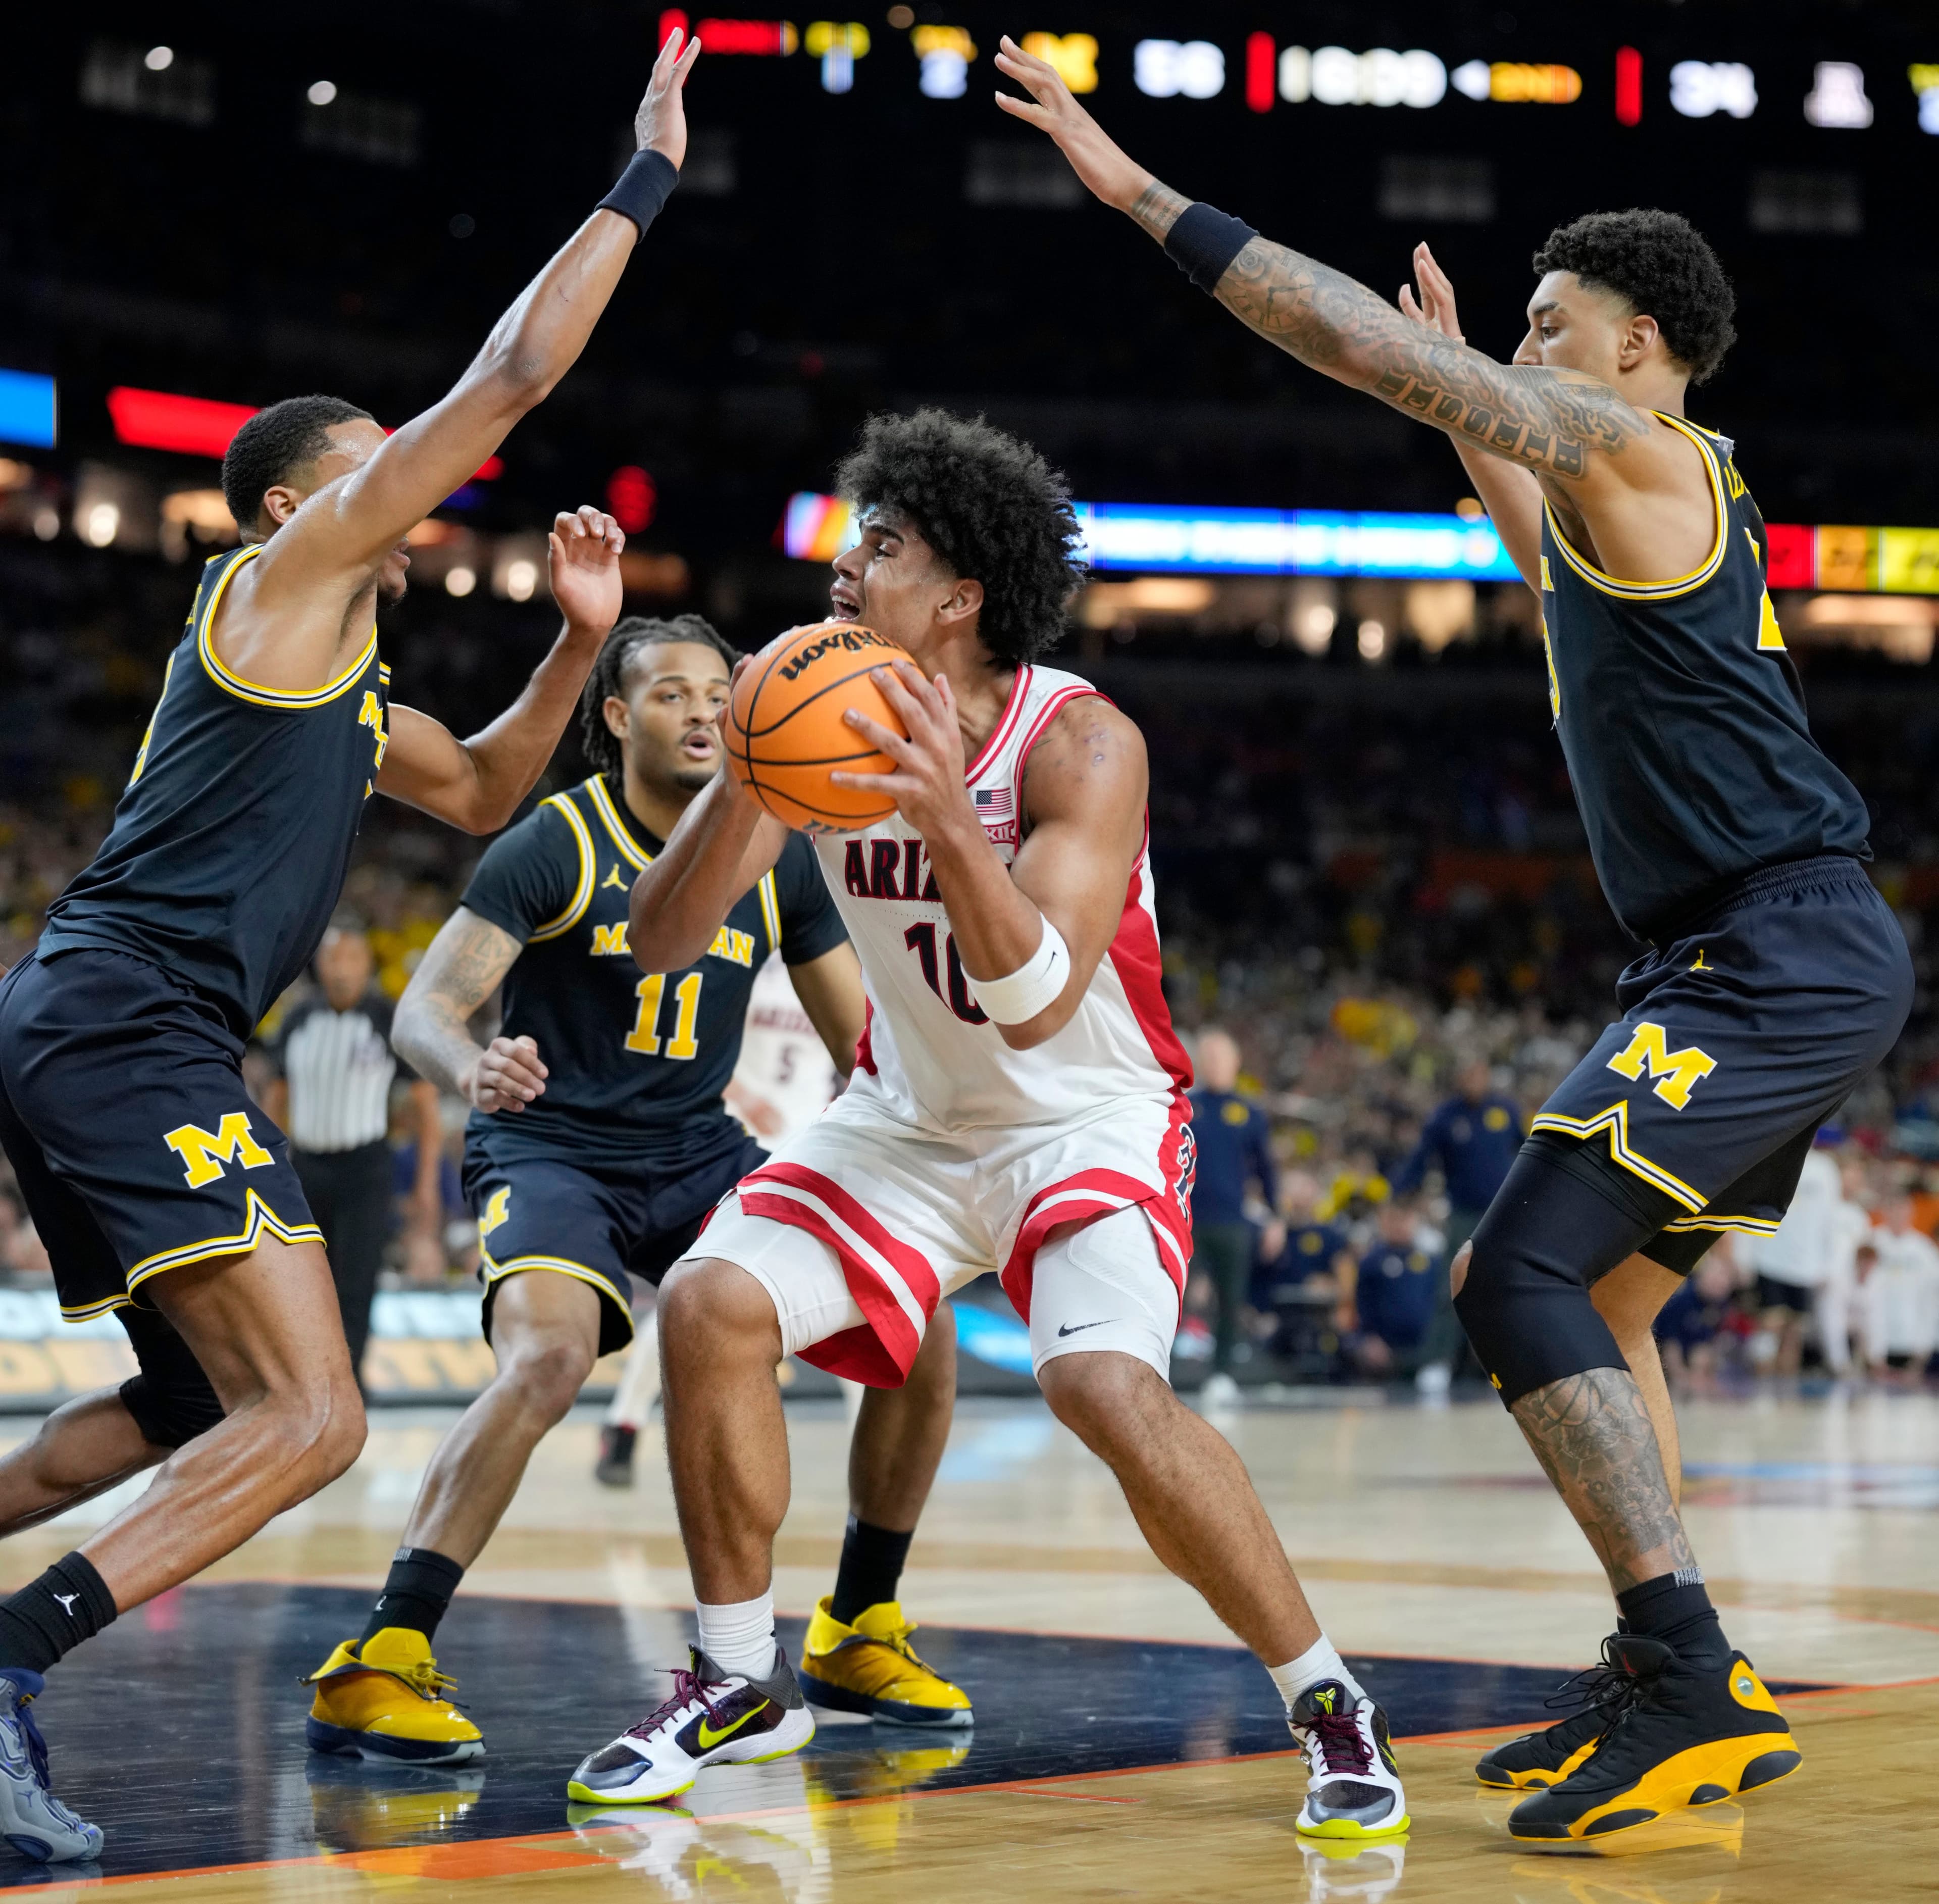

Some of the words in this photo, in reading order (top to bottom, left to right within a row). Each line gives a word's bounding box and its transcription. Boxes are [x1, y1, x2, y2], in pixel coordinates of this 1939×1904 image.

[1373, 367, 1585, 479] BLESSED
[624, 971, 703, 1061] 11
[1606, 1021, 1718, 1112] M
[163, 1112, 275, 1189] M
